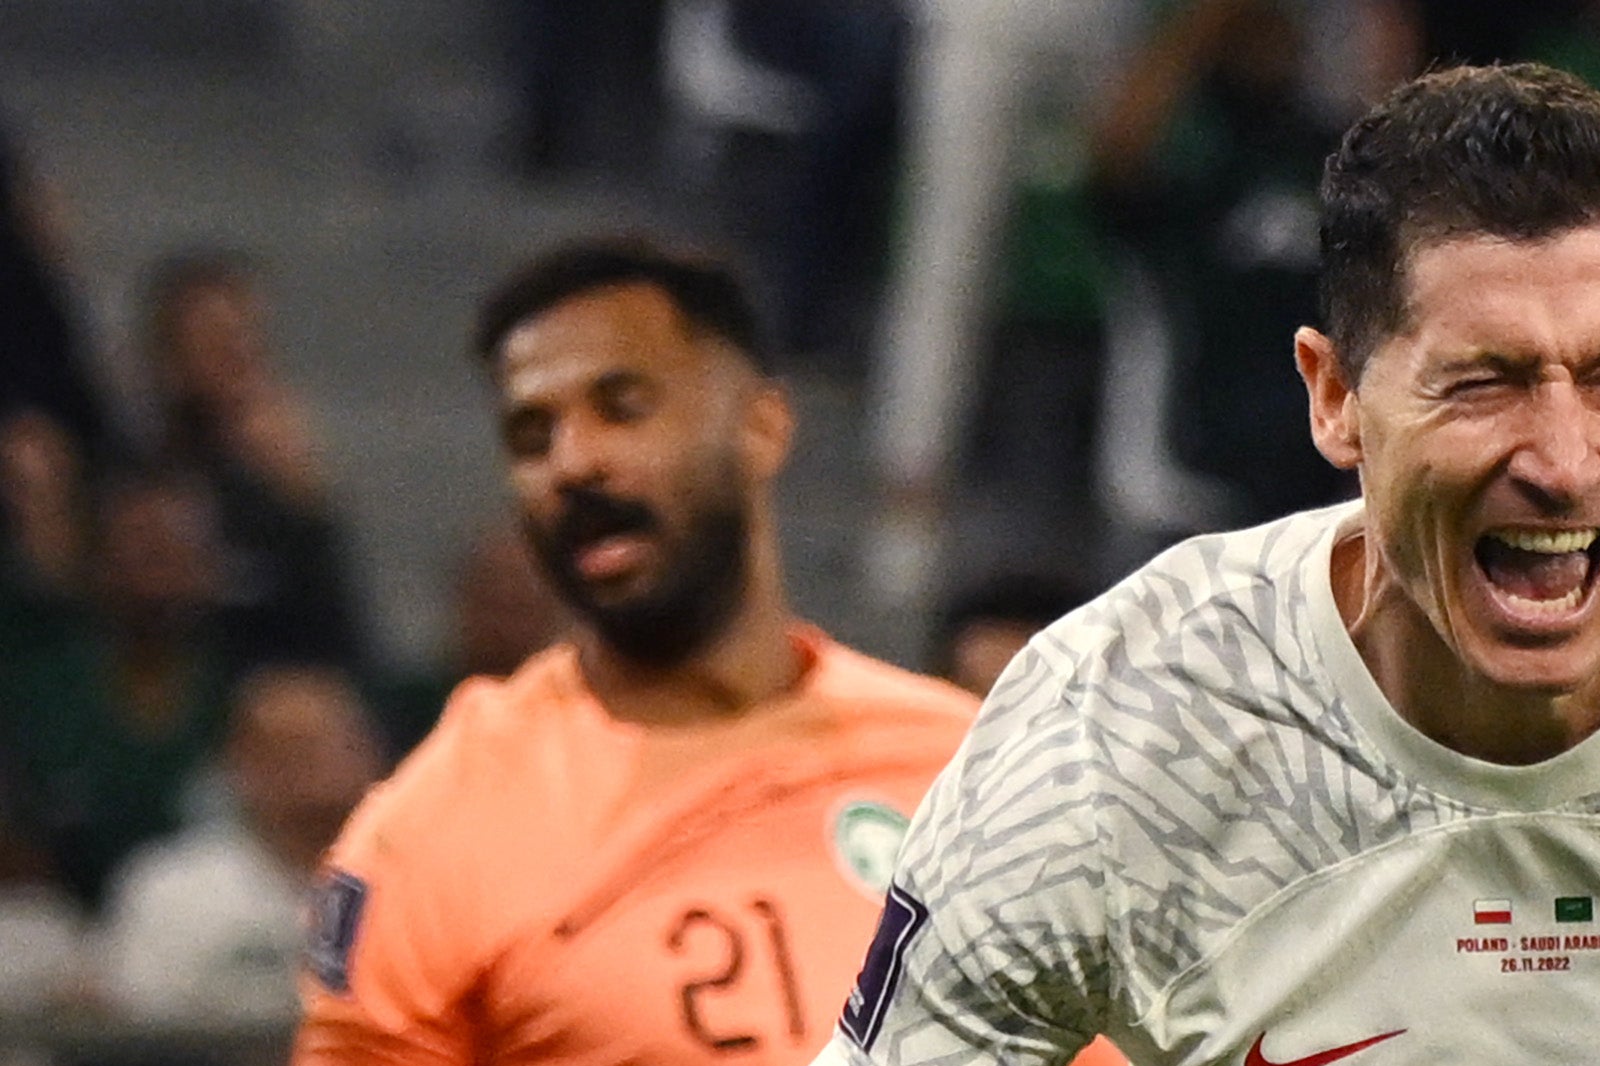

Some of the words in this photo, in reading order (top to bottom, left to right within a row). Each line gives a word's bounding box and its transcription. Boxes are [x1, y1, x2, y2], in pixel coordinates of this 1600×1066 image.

[1457, 938, 1508, 952] POLAND
[1520, 936, 1560, 951] SAUDI
[1501, 957, 1570, 972] 26.11.2022
[667, 900, 805, 1049] 21
